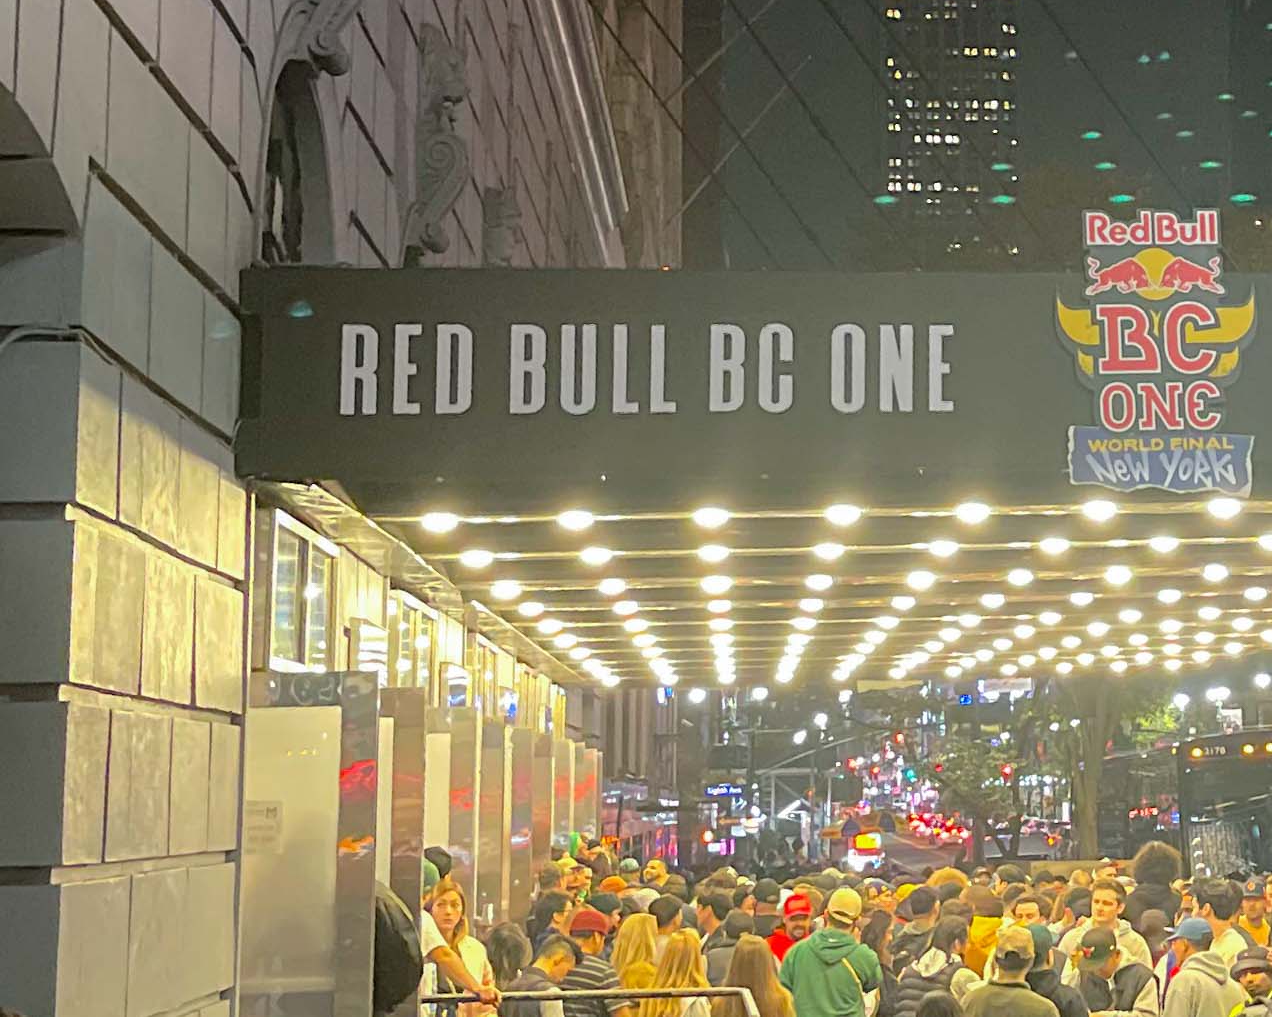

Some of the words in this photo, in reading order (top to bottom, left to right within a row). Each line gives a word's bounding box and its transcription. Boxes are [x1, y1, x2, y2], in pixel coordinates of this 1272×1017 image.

[1086, 211, 1152, 245] Red
[1154, 210, 1218, 245] Bull
[1096, 301, 1217, 374] BC
[339, 323, 474, 415] RED
[509, 323, 677, 415] BULL
[709, 323, 793, 414] BC
[831, 323, 954, 414] ONE
[1100, 380, 1221, 432] ONE
[1088, 437, 1164, 453] WORLD
[1170, 436, 1235, 451] FINAL
